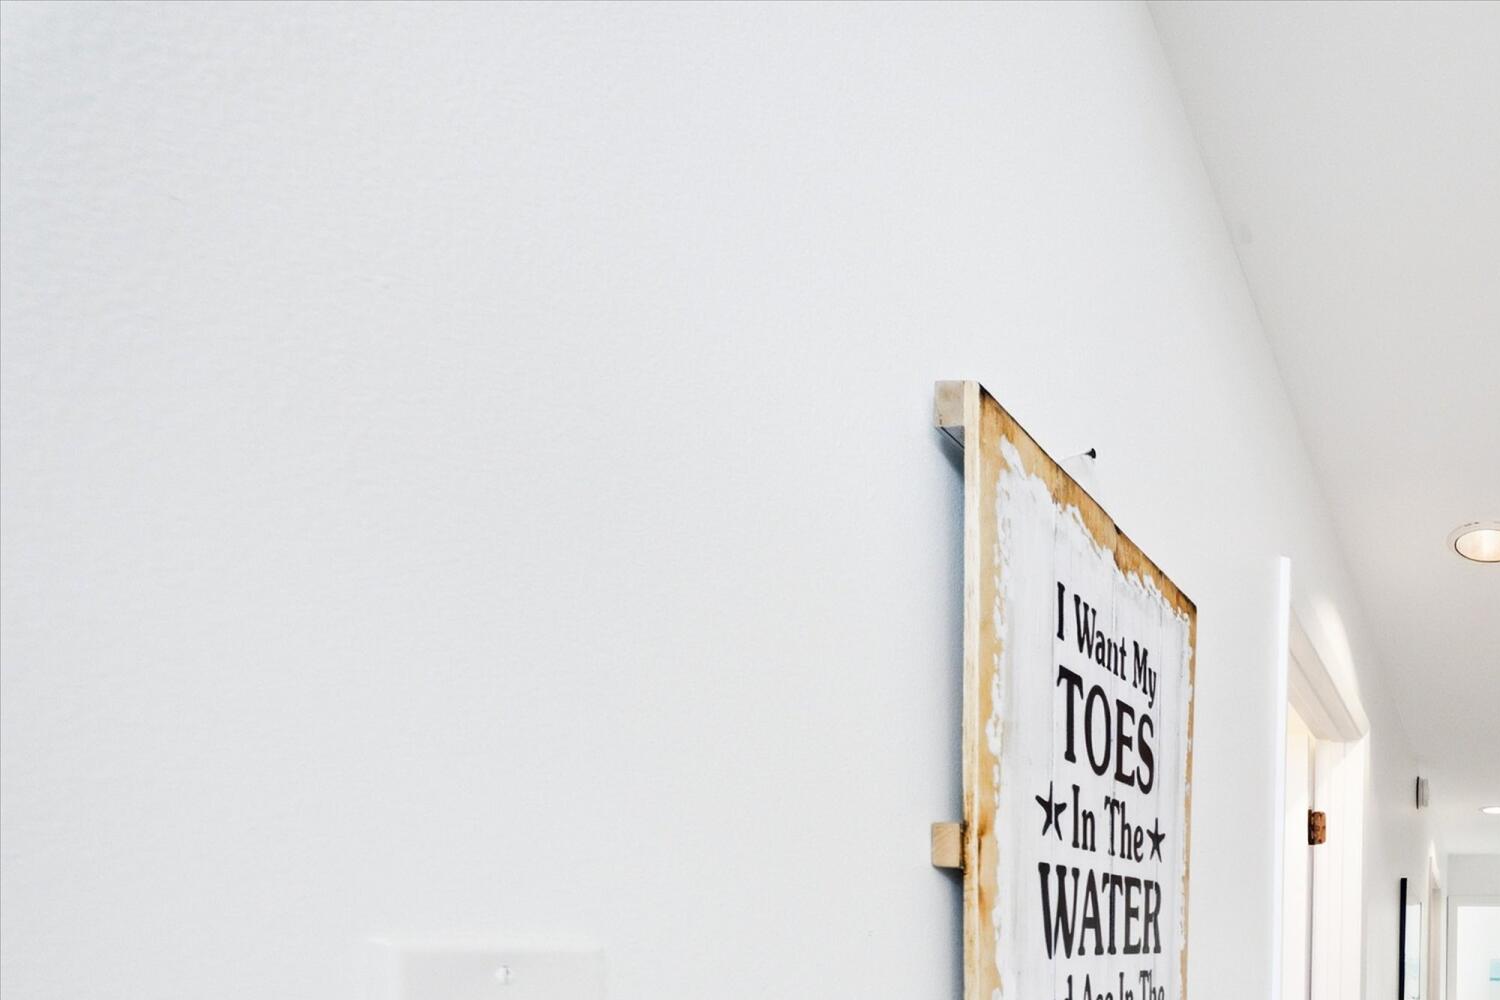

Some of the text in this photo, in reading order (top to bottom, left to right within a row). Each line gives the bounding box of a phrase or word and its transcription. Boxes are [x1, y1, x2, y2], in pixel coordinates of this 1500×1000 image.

[1056, 581, 1157, 709] I Want My
[1056, 664, 1154, 795] TOES
[1072, 784, 1144, 863] In The
[1038, 862, 1162, 960] WATER
